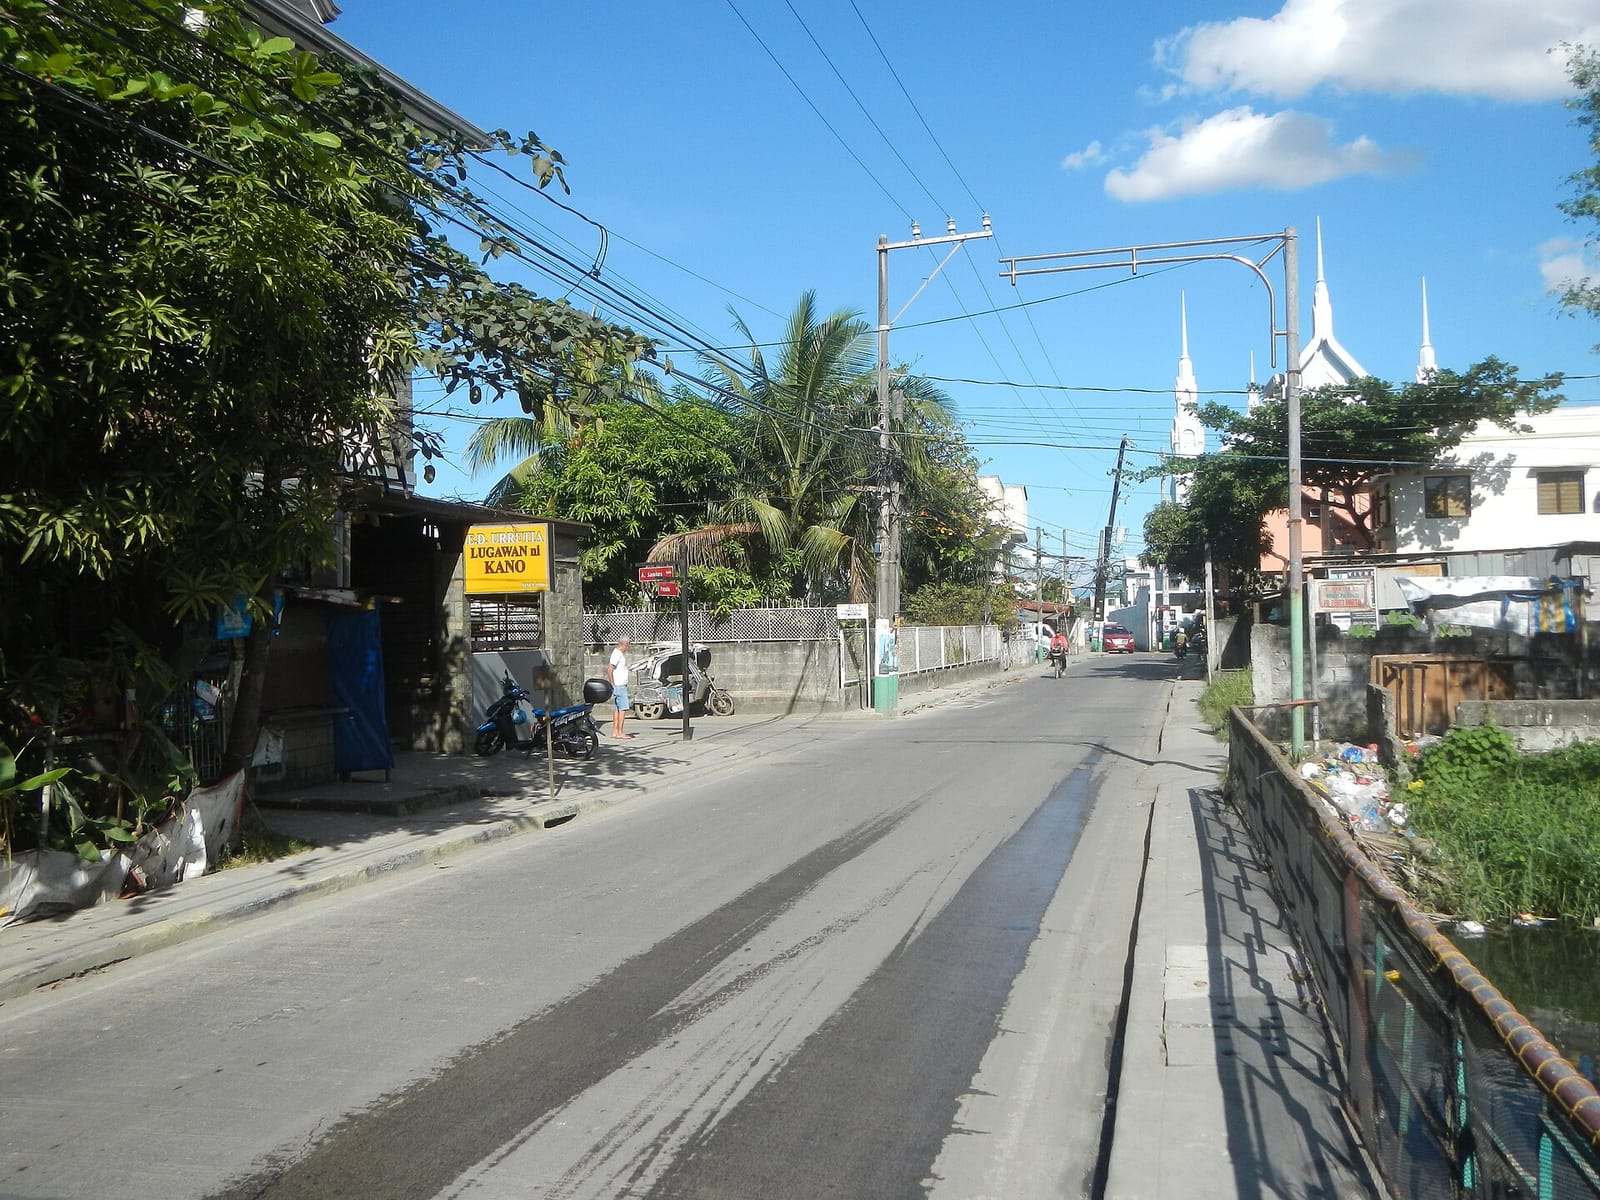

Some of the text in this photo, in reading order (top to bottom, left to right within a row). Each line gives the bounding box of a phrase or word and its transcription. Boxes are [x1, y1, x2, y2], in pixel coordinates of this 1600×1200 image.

[490, 531, 544, 544] URRUTIA
[470, 545, 541, 559] LUGAWAN ni
[484, 560, 526, 574] KANO
